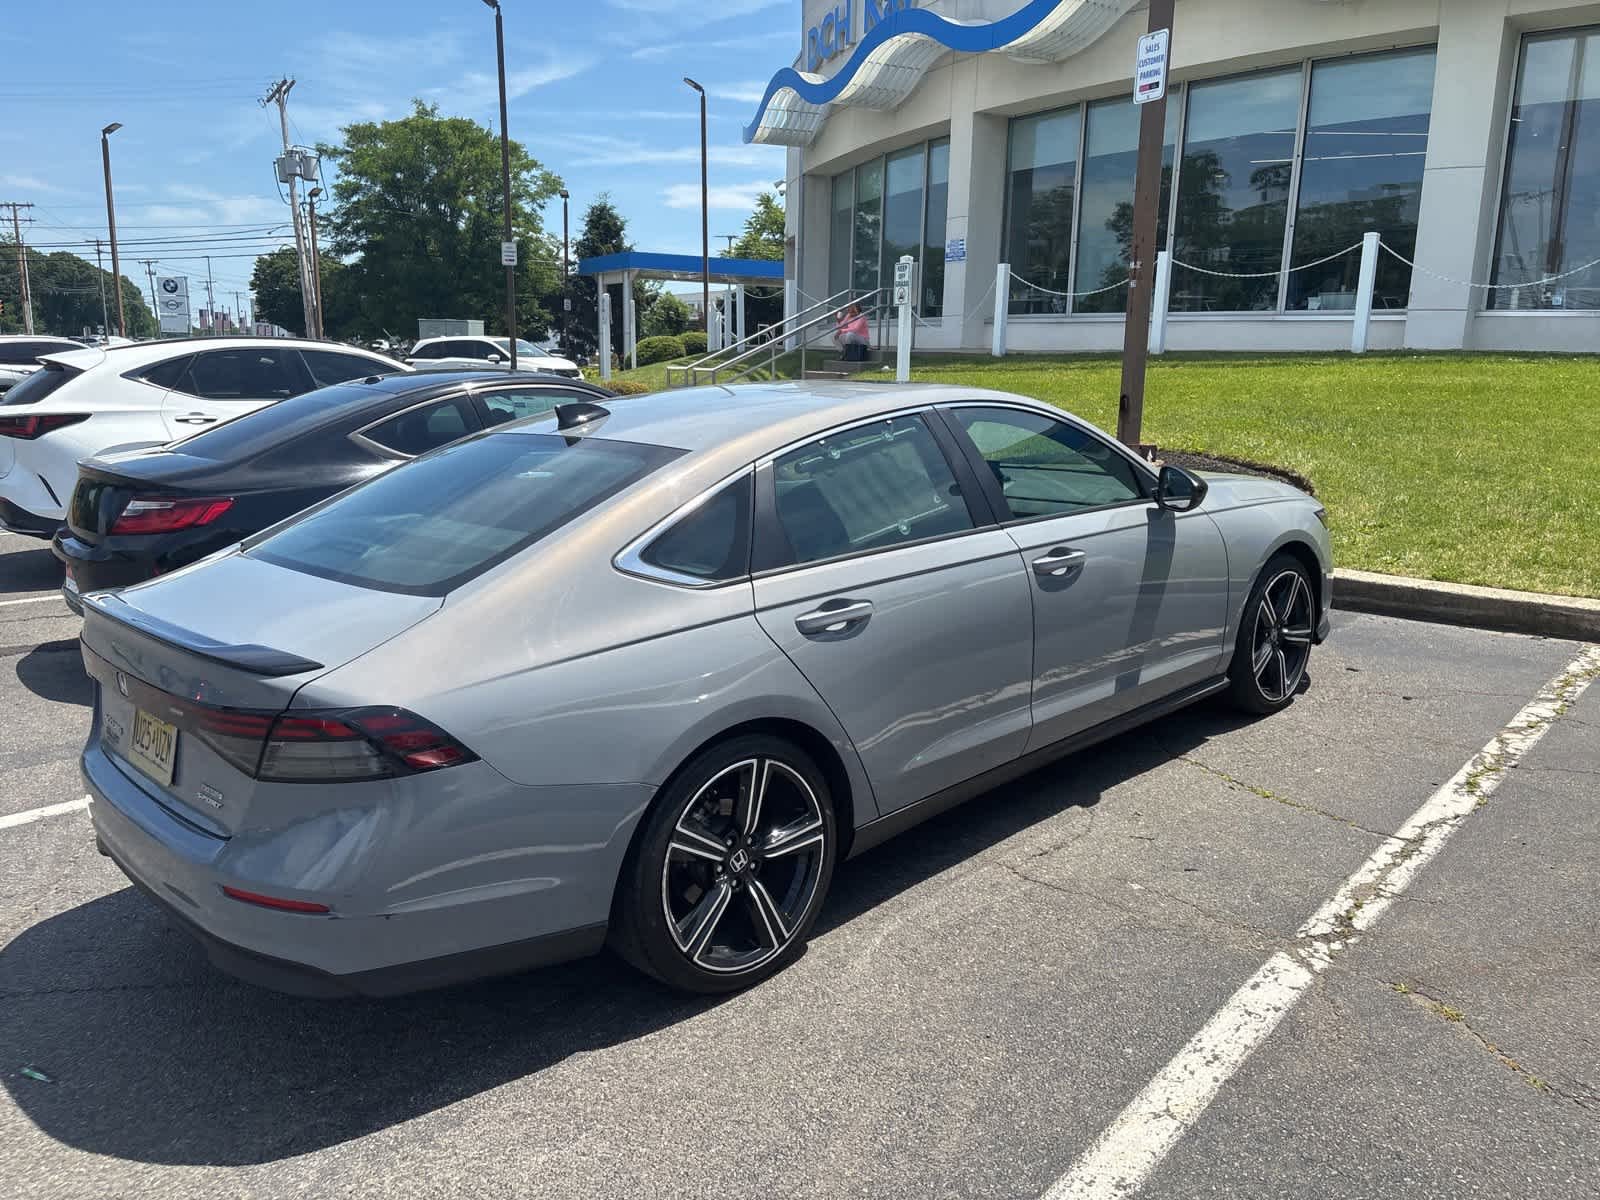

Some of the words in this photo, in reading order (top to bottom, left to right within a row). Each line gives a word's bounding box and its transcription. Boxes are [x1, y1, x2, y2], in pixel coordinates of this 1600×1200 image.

[807, 0, 850, 73] DCH
[1145, 43, 1160, 54] SALES
[1138, 54, 1164, 68] CUSTOMER
[1140, 69, 1161, 81] PARKING
